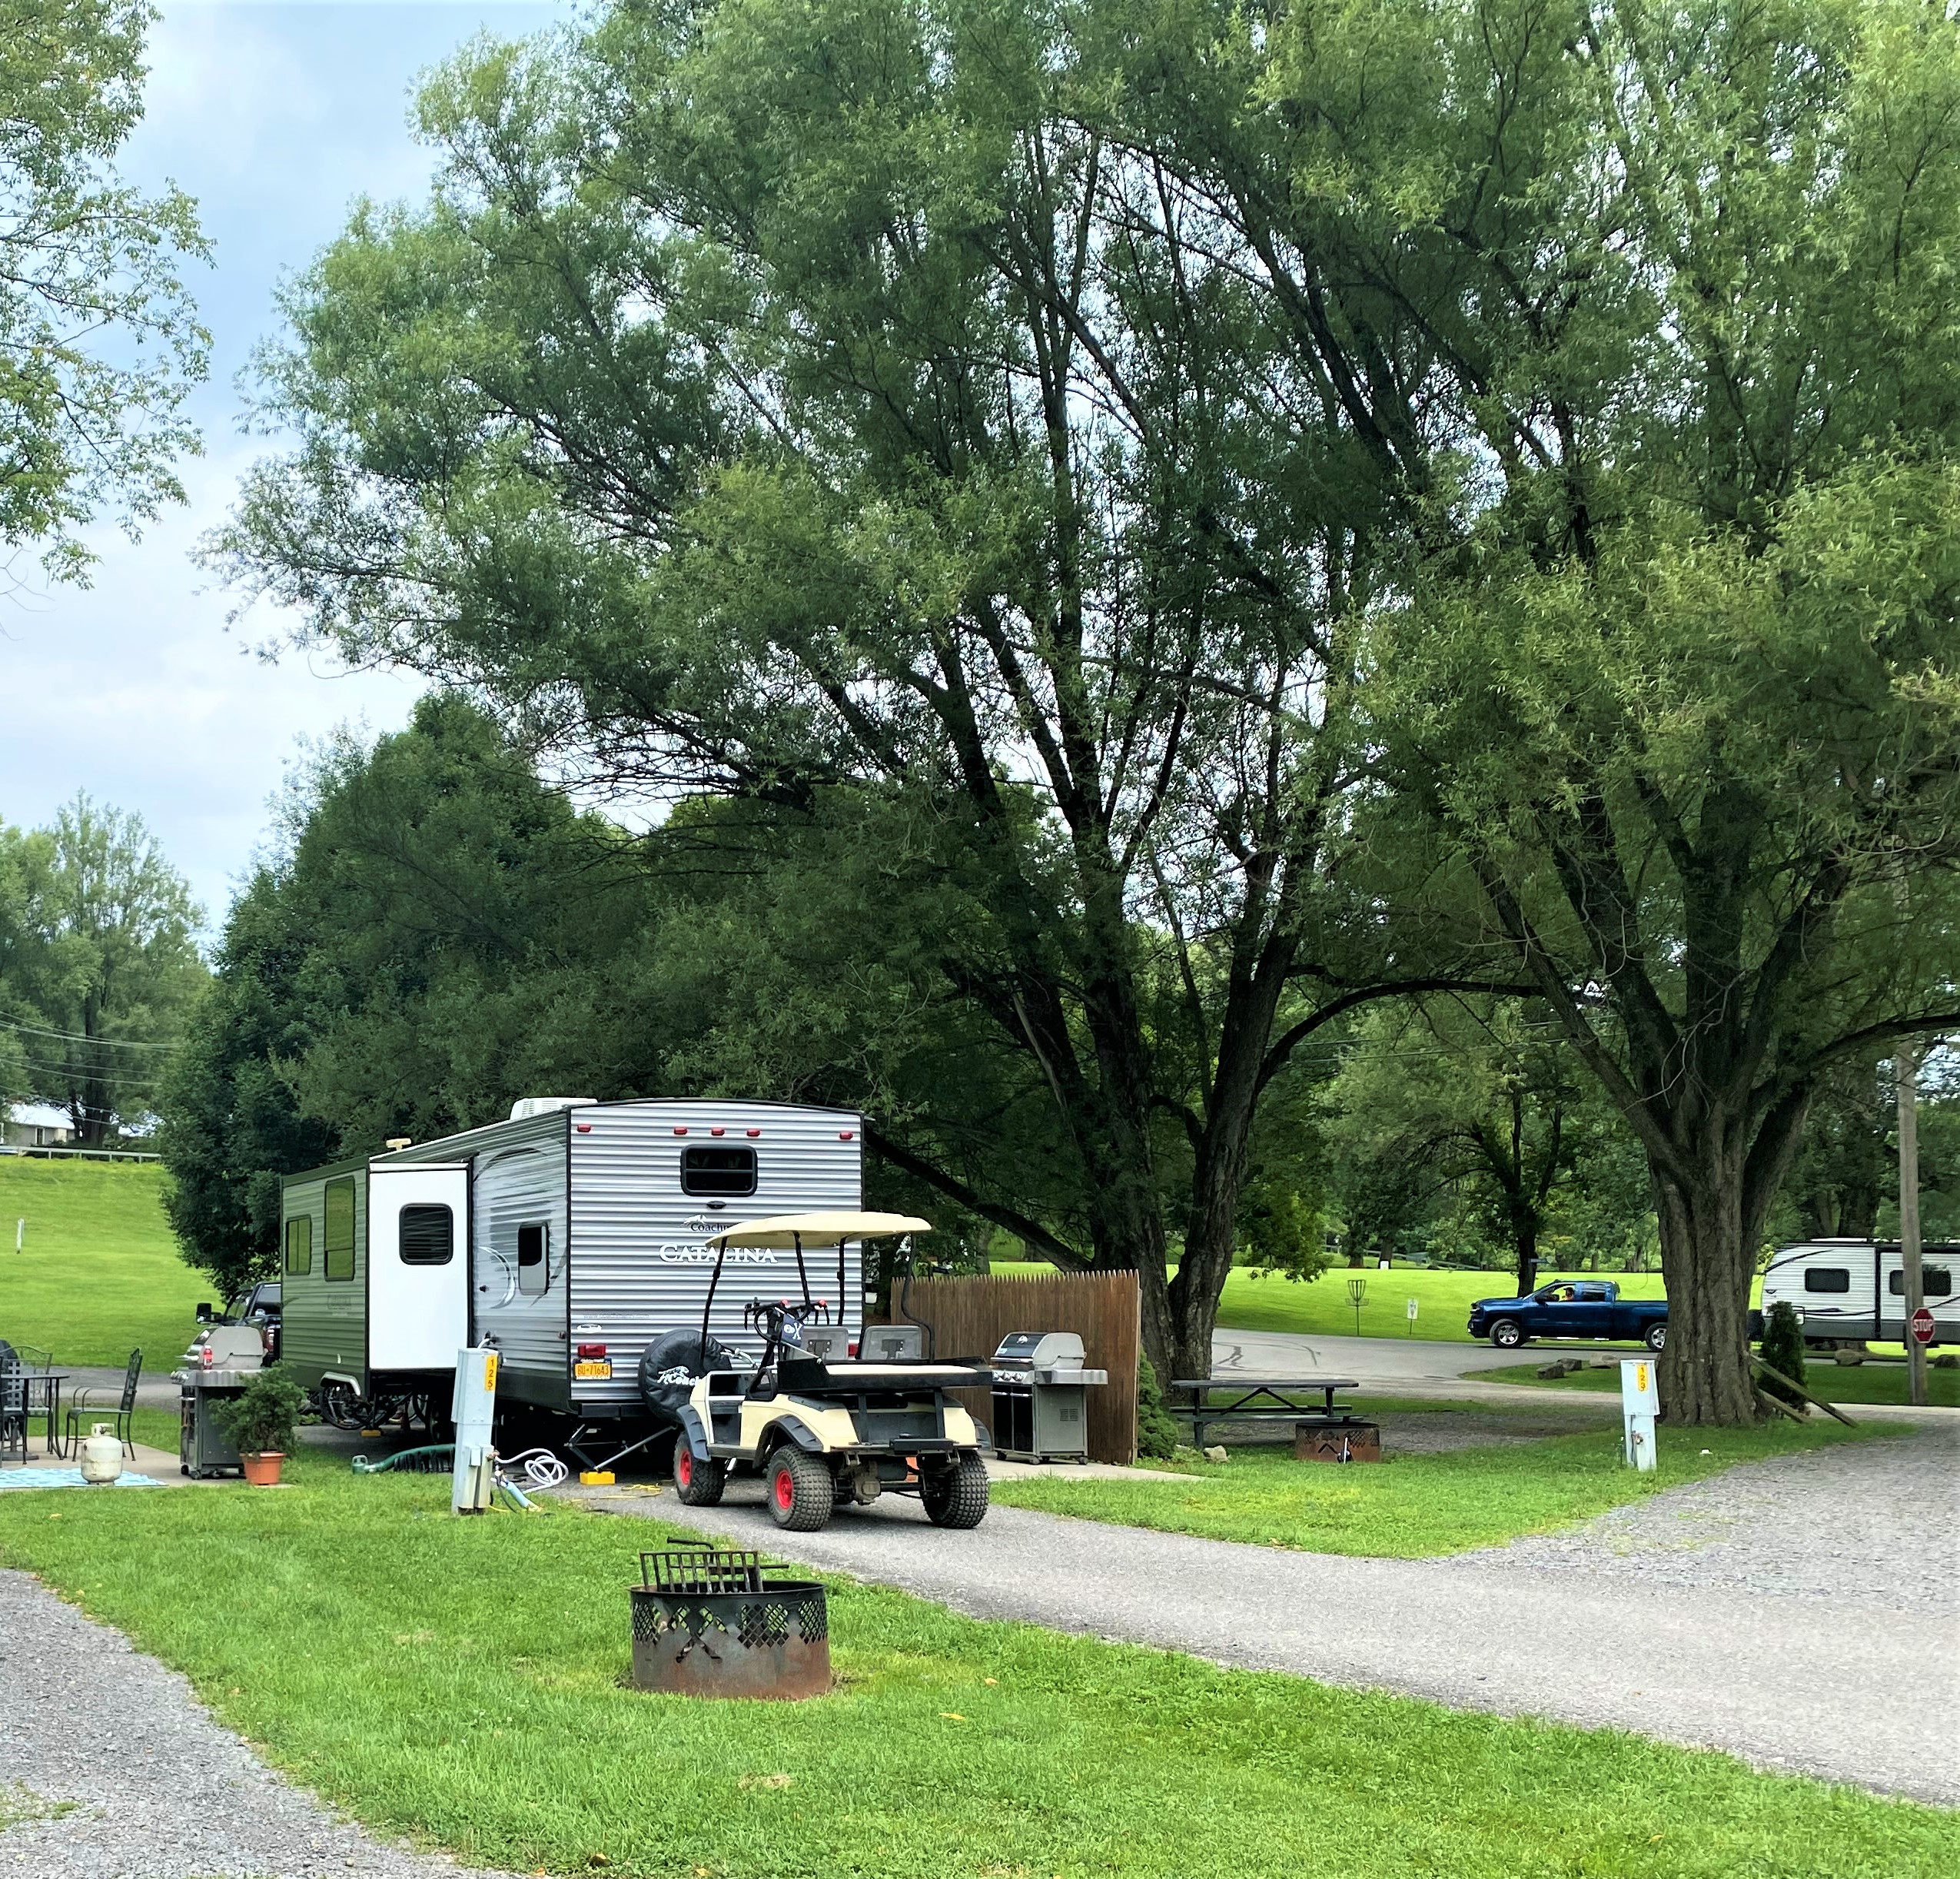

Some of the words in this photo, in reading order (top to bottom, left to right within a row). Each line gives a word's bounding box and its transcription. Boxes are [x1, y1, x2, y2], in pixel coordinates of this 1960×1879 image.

[690, 1222, 729, 1232] Coach
[659, 1243, 778, 1263] CATALINA
[1913, 1319, 1933, 1332] STOP
